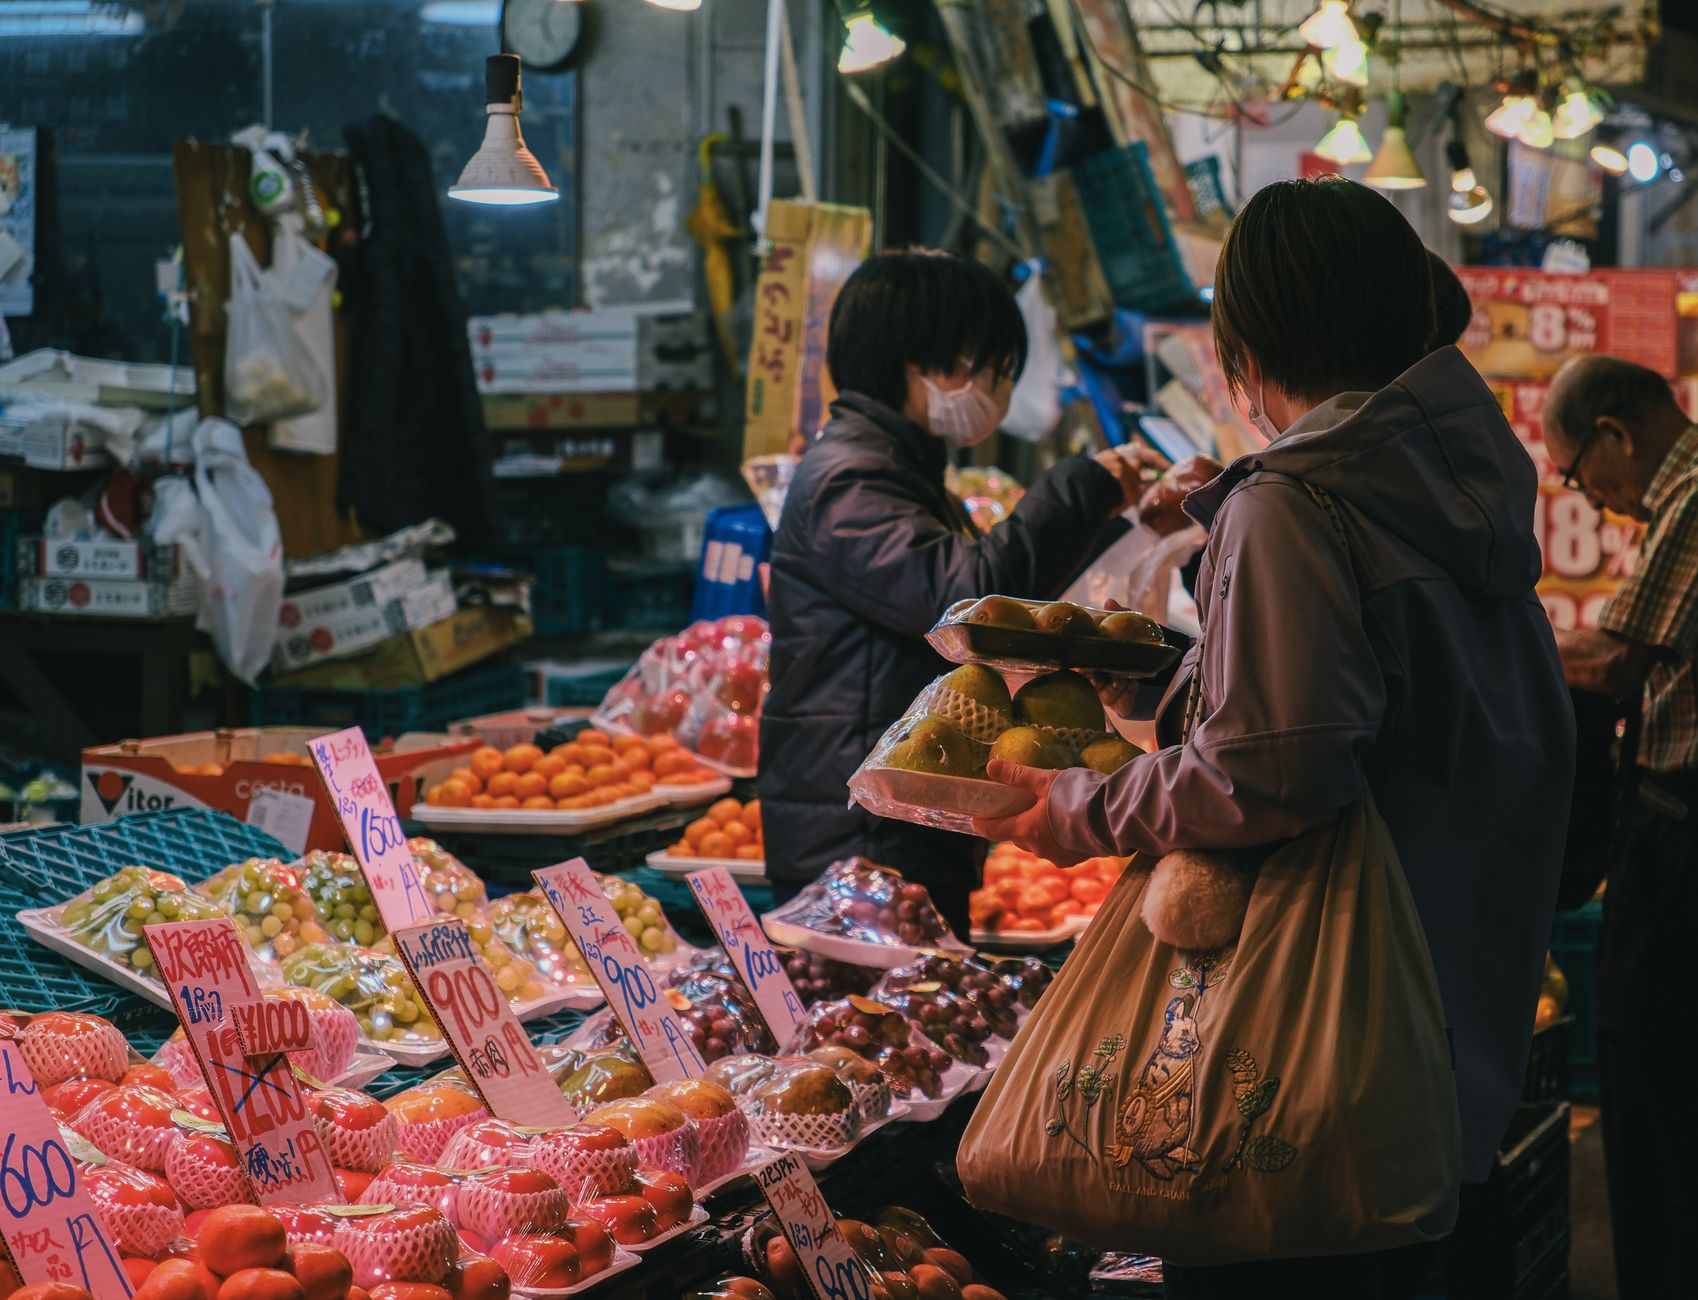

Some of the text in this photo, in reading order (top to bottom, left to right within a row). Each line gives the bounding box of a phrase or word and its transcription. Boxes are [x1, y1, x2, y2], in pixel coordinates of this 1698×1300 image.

[361, 807, 404, 863] 1500
[744, 942, 780, 992] 1000
[428, 965, 500, 1047] 900
[603, 955, 657, 1050] 900
[501, 1021, 539, 1078] 円
